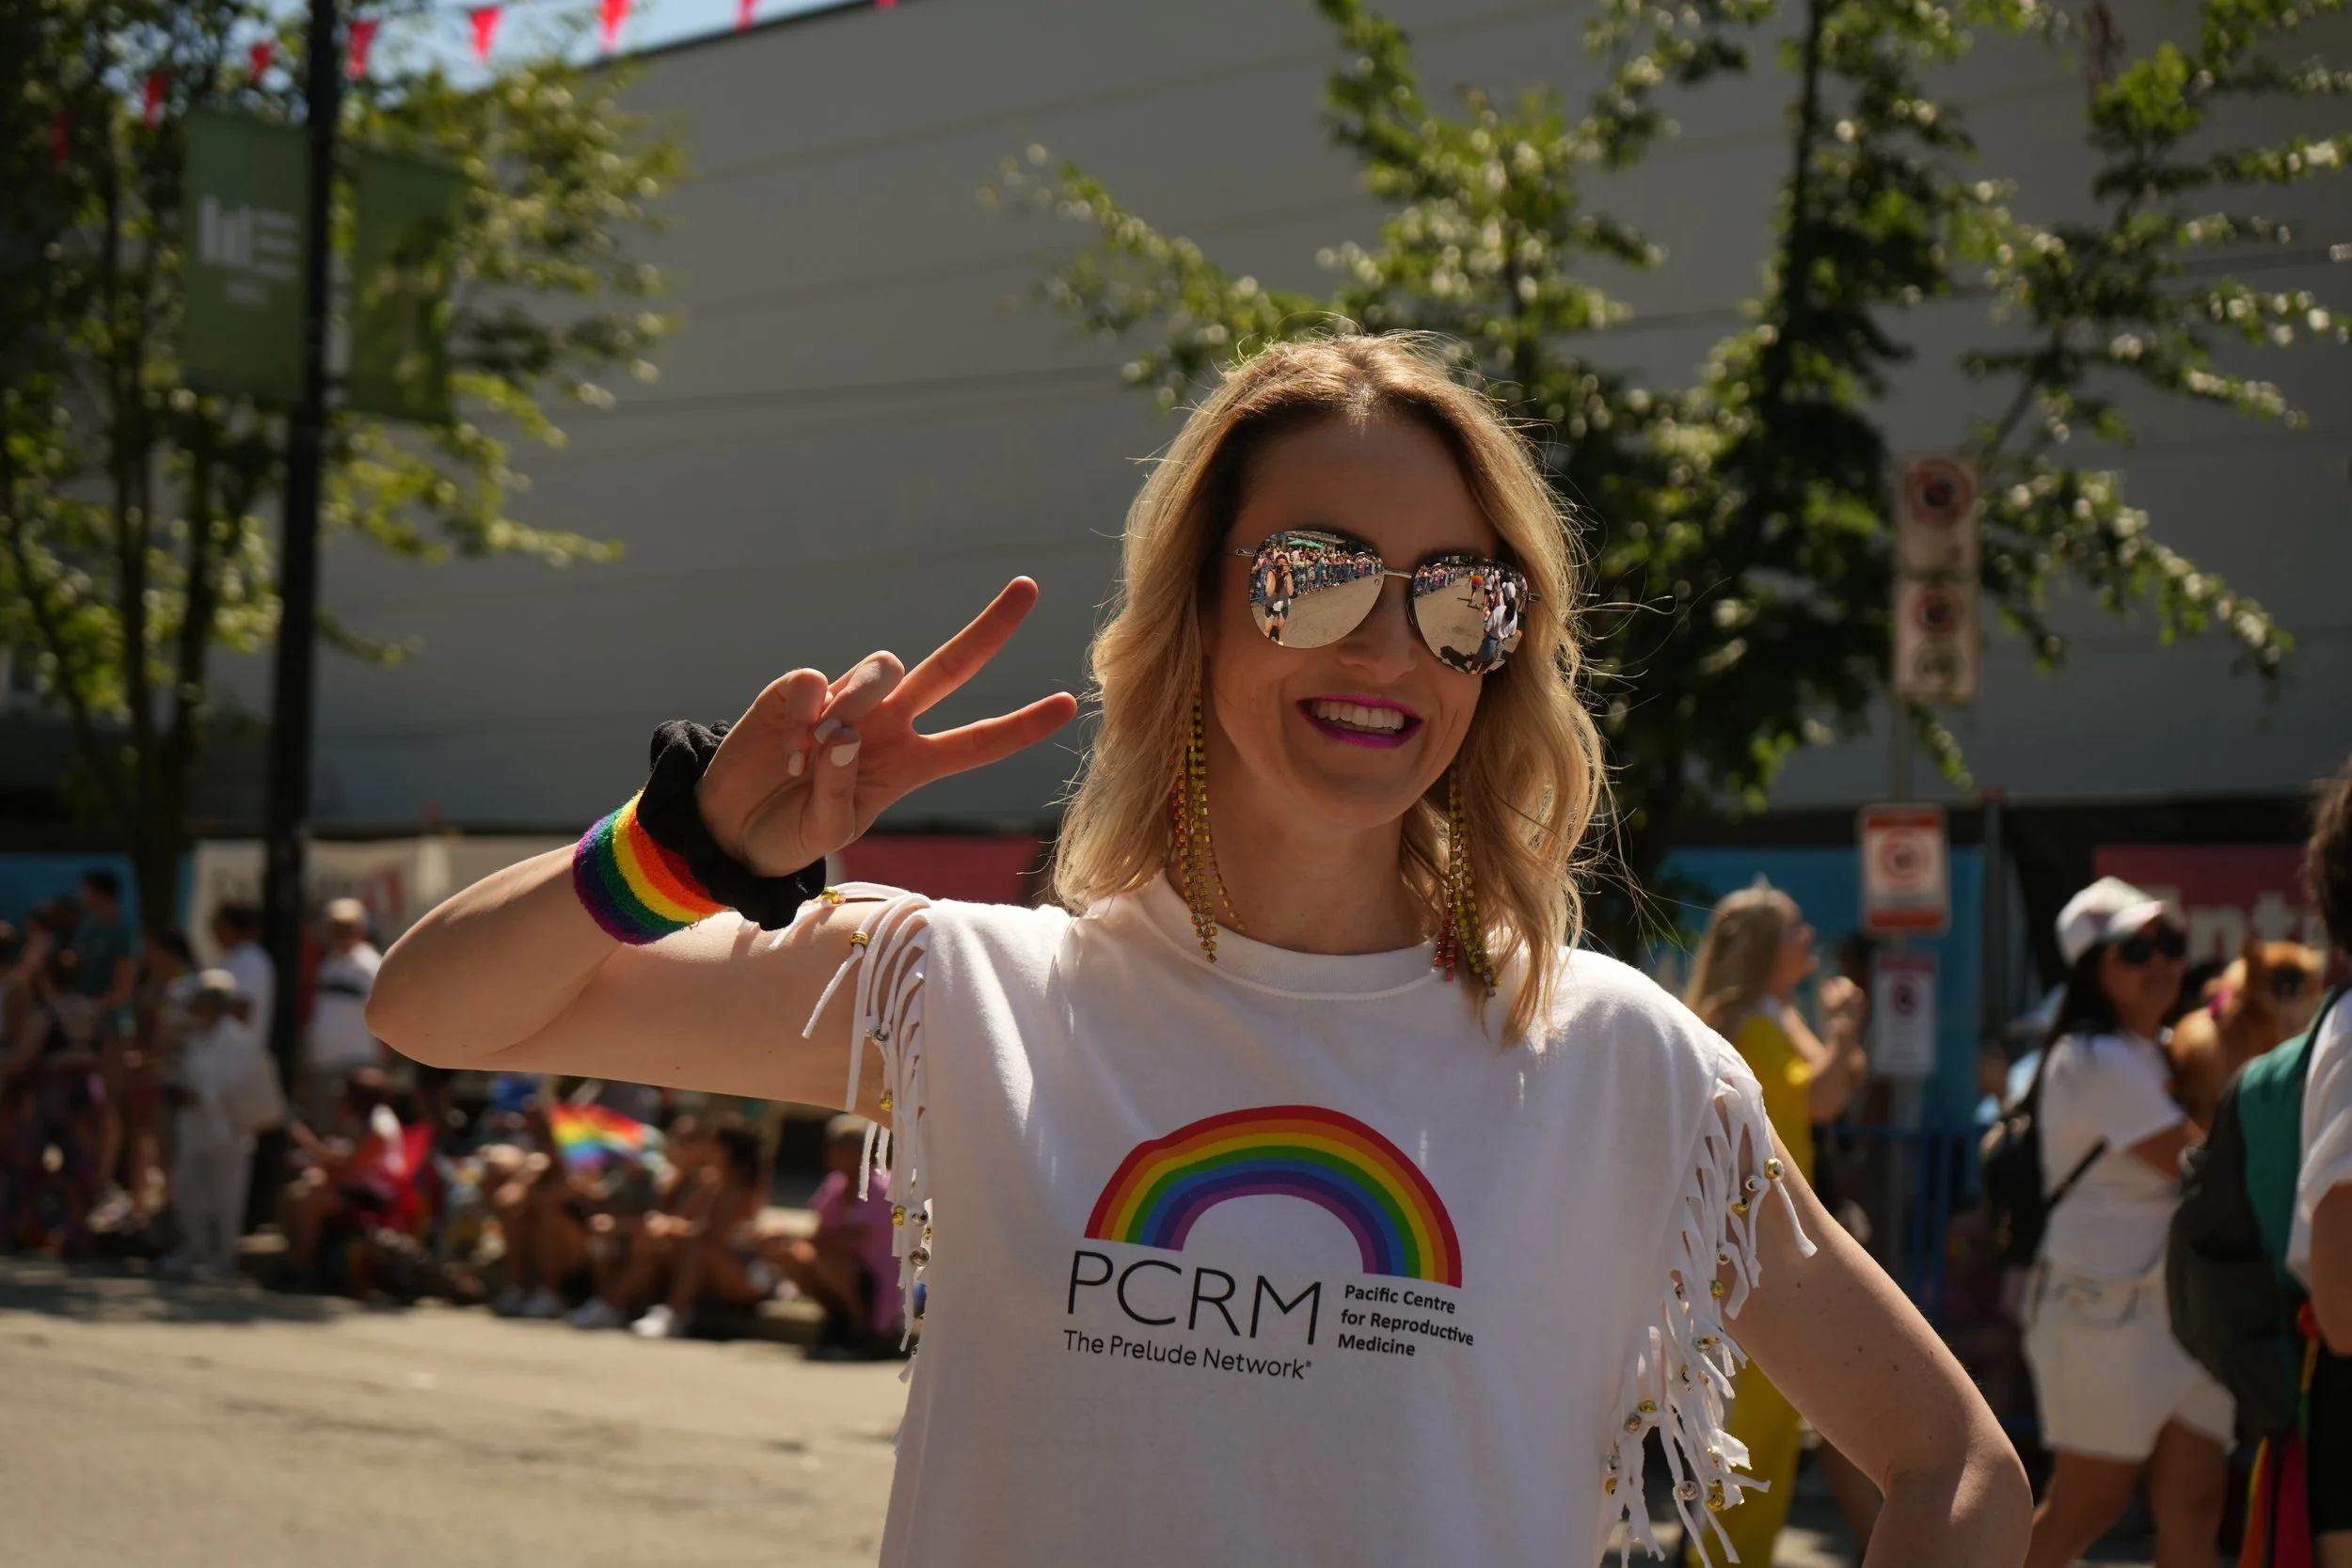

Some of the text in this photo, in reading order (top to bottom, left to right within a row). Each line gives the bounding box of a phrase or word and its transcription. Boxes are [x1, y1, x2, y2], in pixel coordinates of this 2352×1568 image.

[1067, 1249, 1323, 1346] PCRM
[1344, 1284, 1455, 1315] Pacific Centre
[1338, 1333, 1416, 1356] Medicine
[1341, 1308, 1474, 1347] for Reproductive
[1063, 1329, 1104, 1354] The
[1109, 1334, 1198, 1367] Prelude
